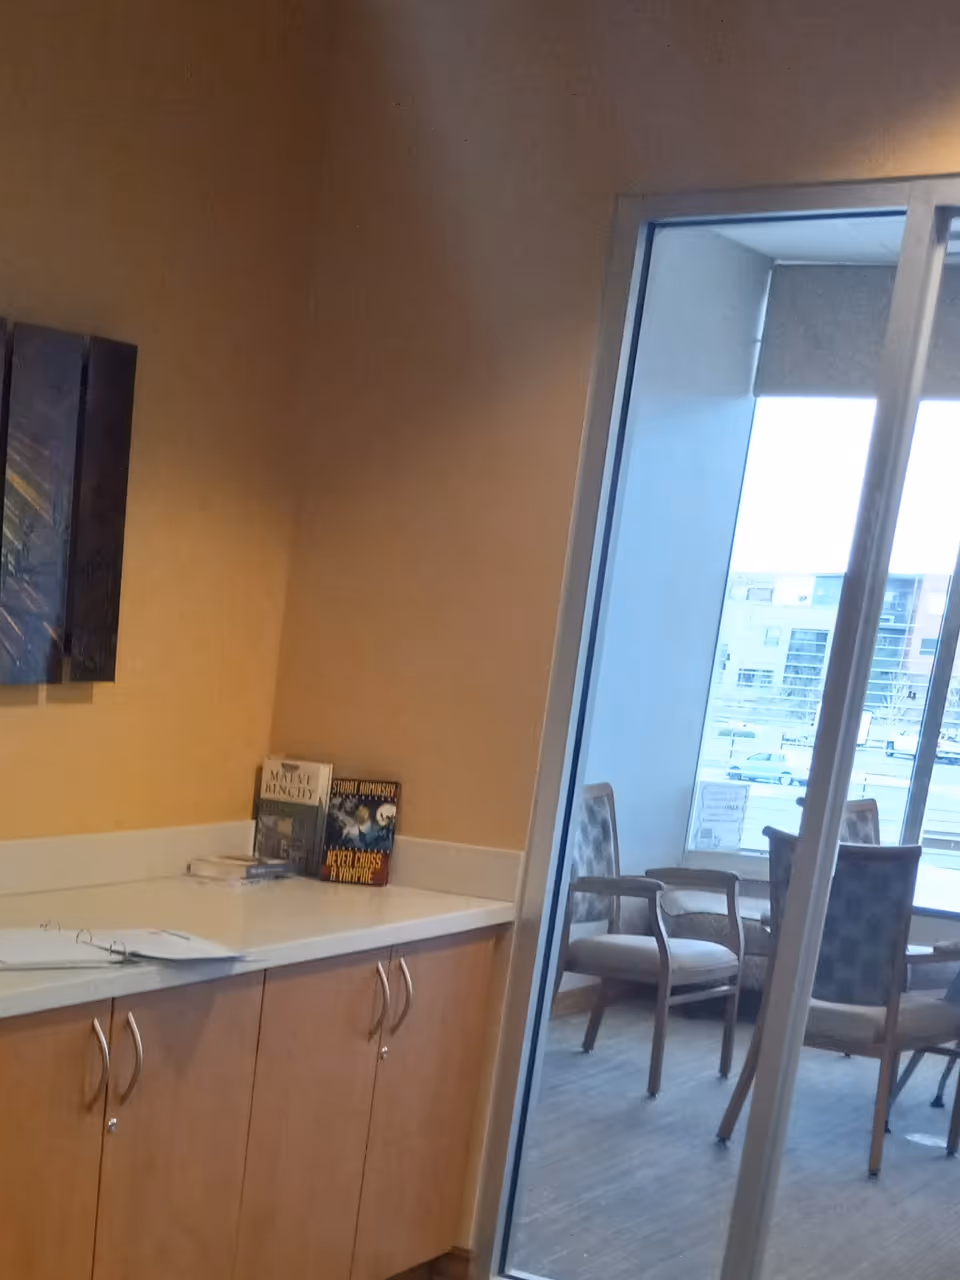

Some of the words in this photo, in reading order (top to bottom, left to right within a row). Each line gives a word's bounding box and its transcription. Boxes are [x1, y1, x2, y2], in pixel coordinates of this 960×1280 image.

[332, 780, 359, 795] STUART
[326, 850, 354, 867] NEVER
[355, 852, 382, 869] CROSS
[330, 864, 337, 881] A
[339, 866, 375, 884] VAMPIRE
